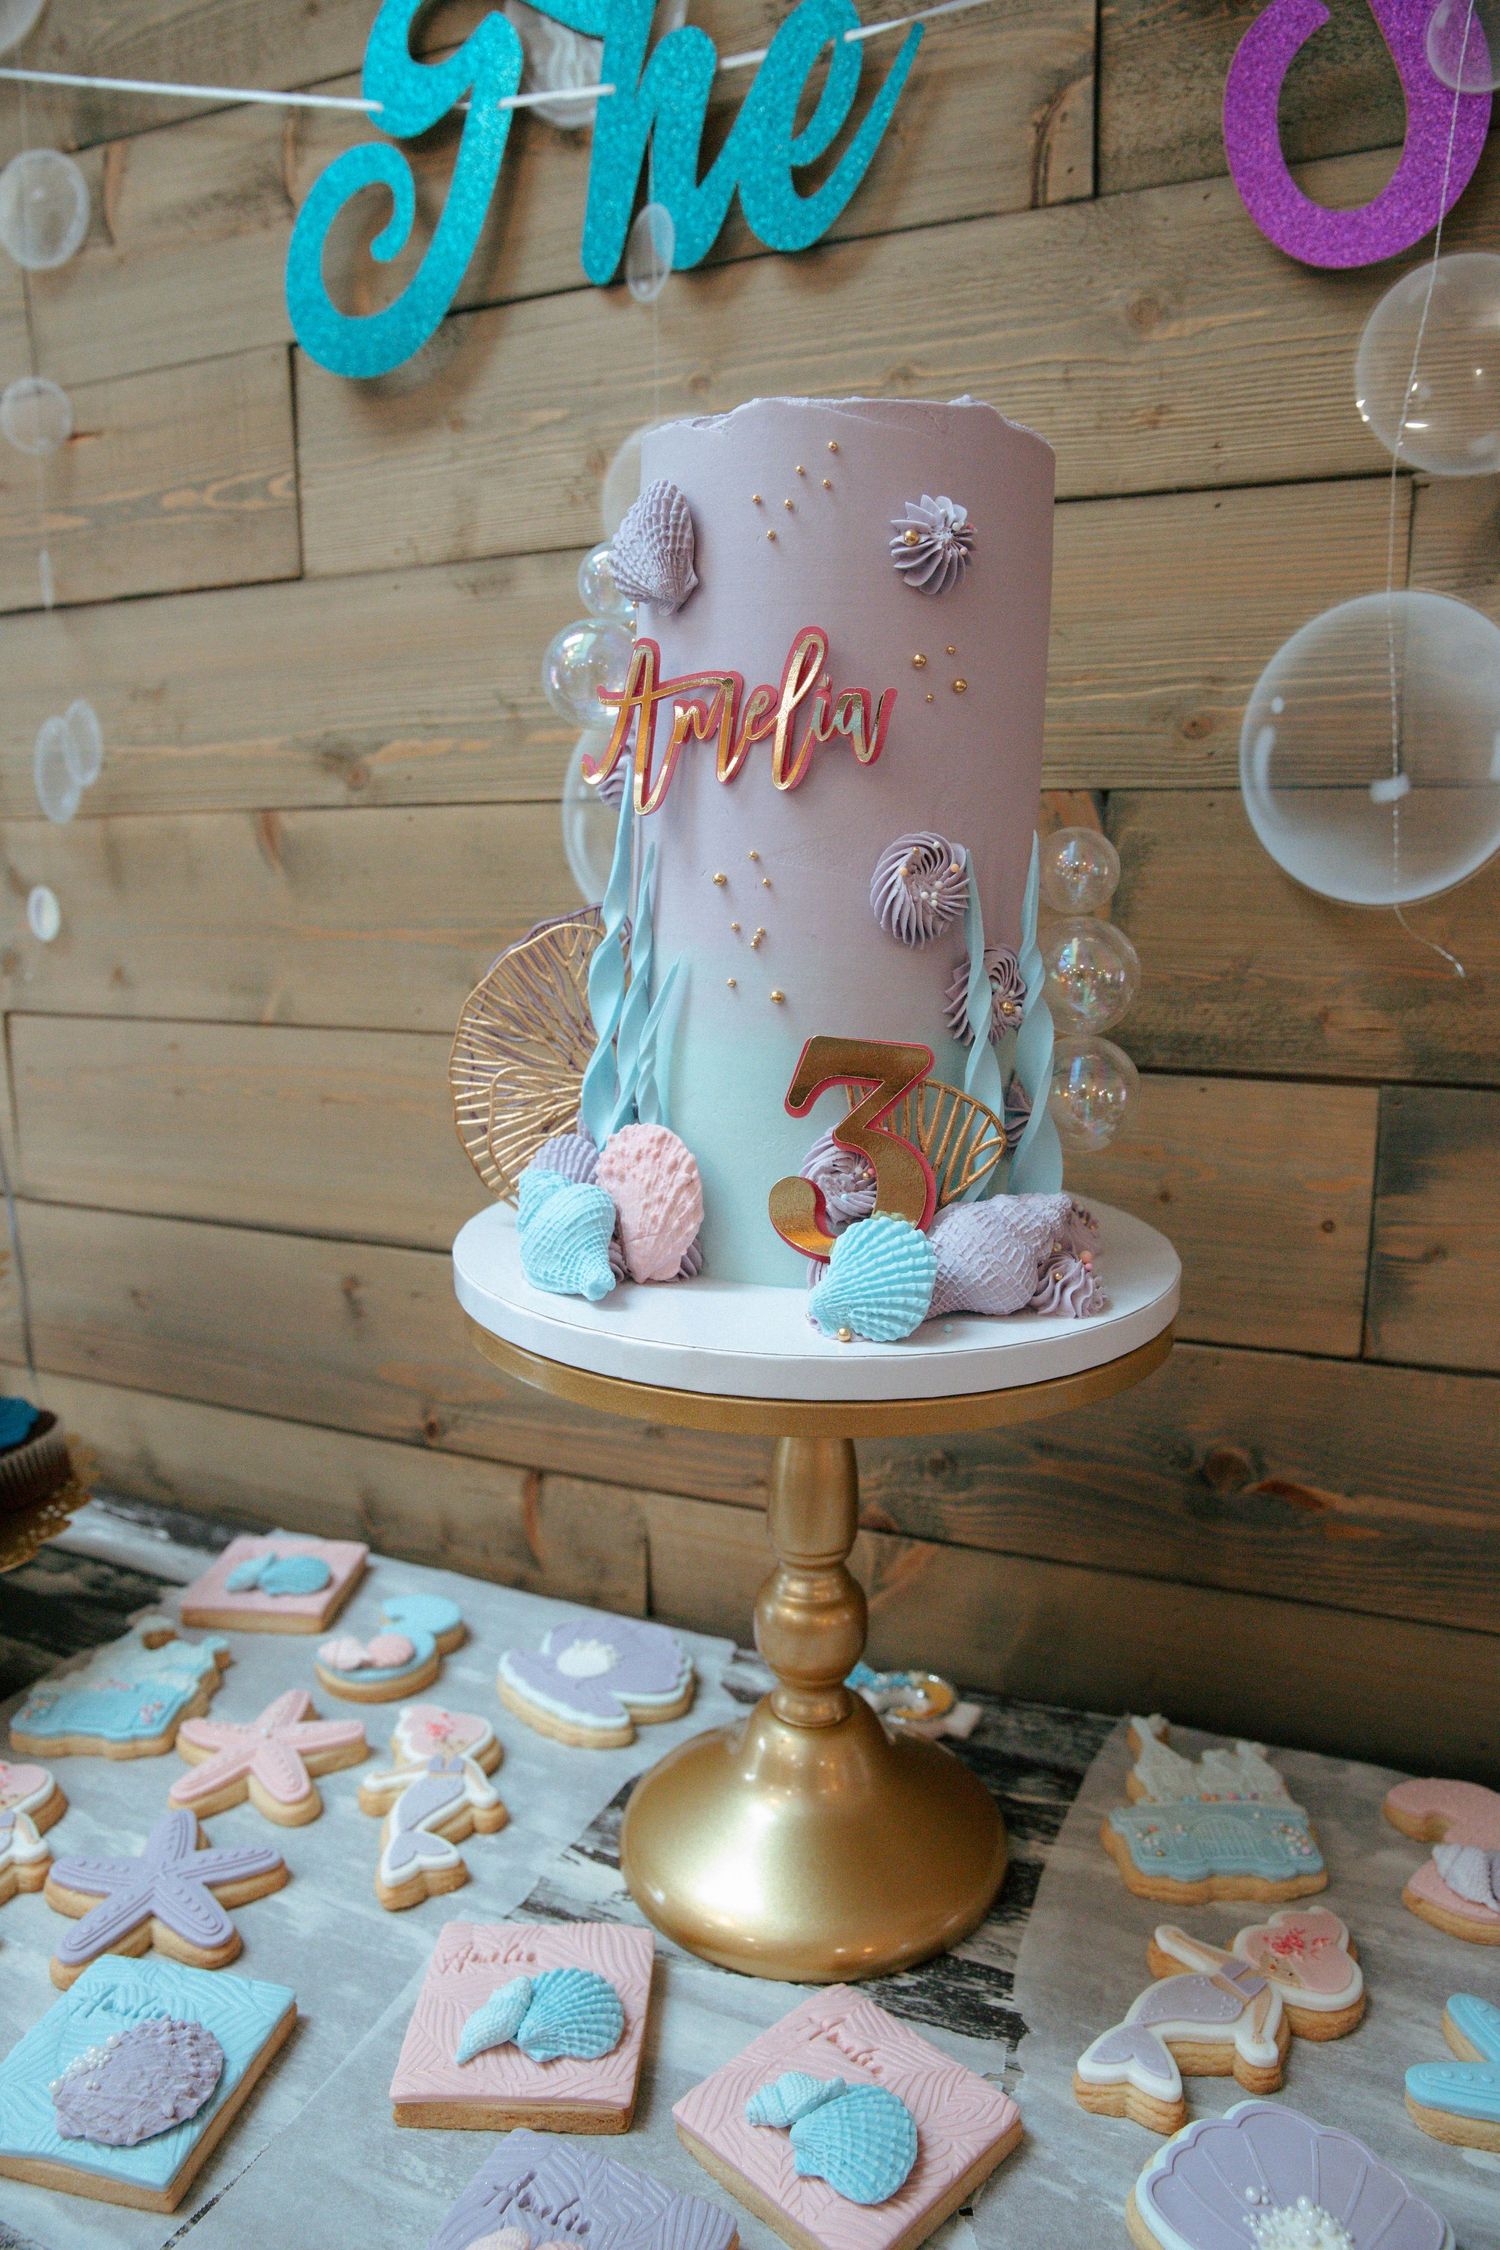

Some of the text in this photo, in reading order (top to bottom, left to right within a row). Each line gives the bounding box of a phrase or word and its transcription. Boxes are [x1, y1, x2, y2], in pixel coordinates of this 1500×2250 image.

[287, 0, 925, 378] The
[581, 625, 898, 815] Amelia
[768, 1035, 936, 1264] 3
